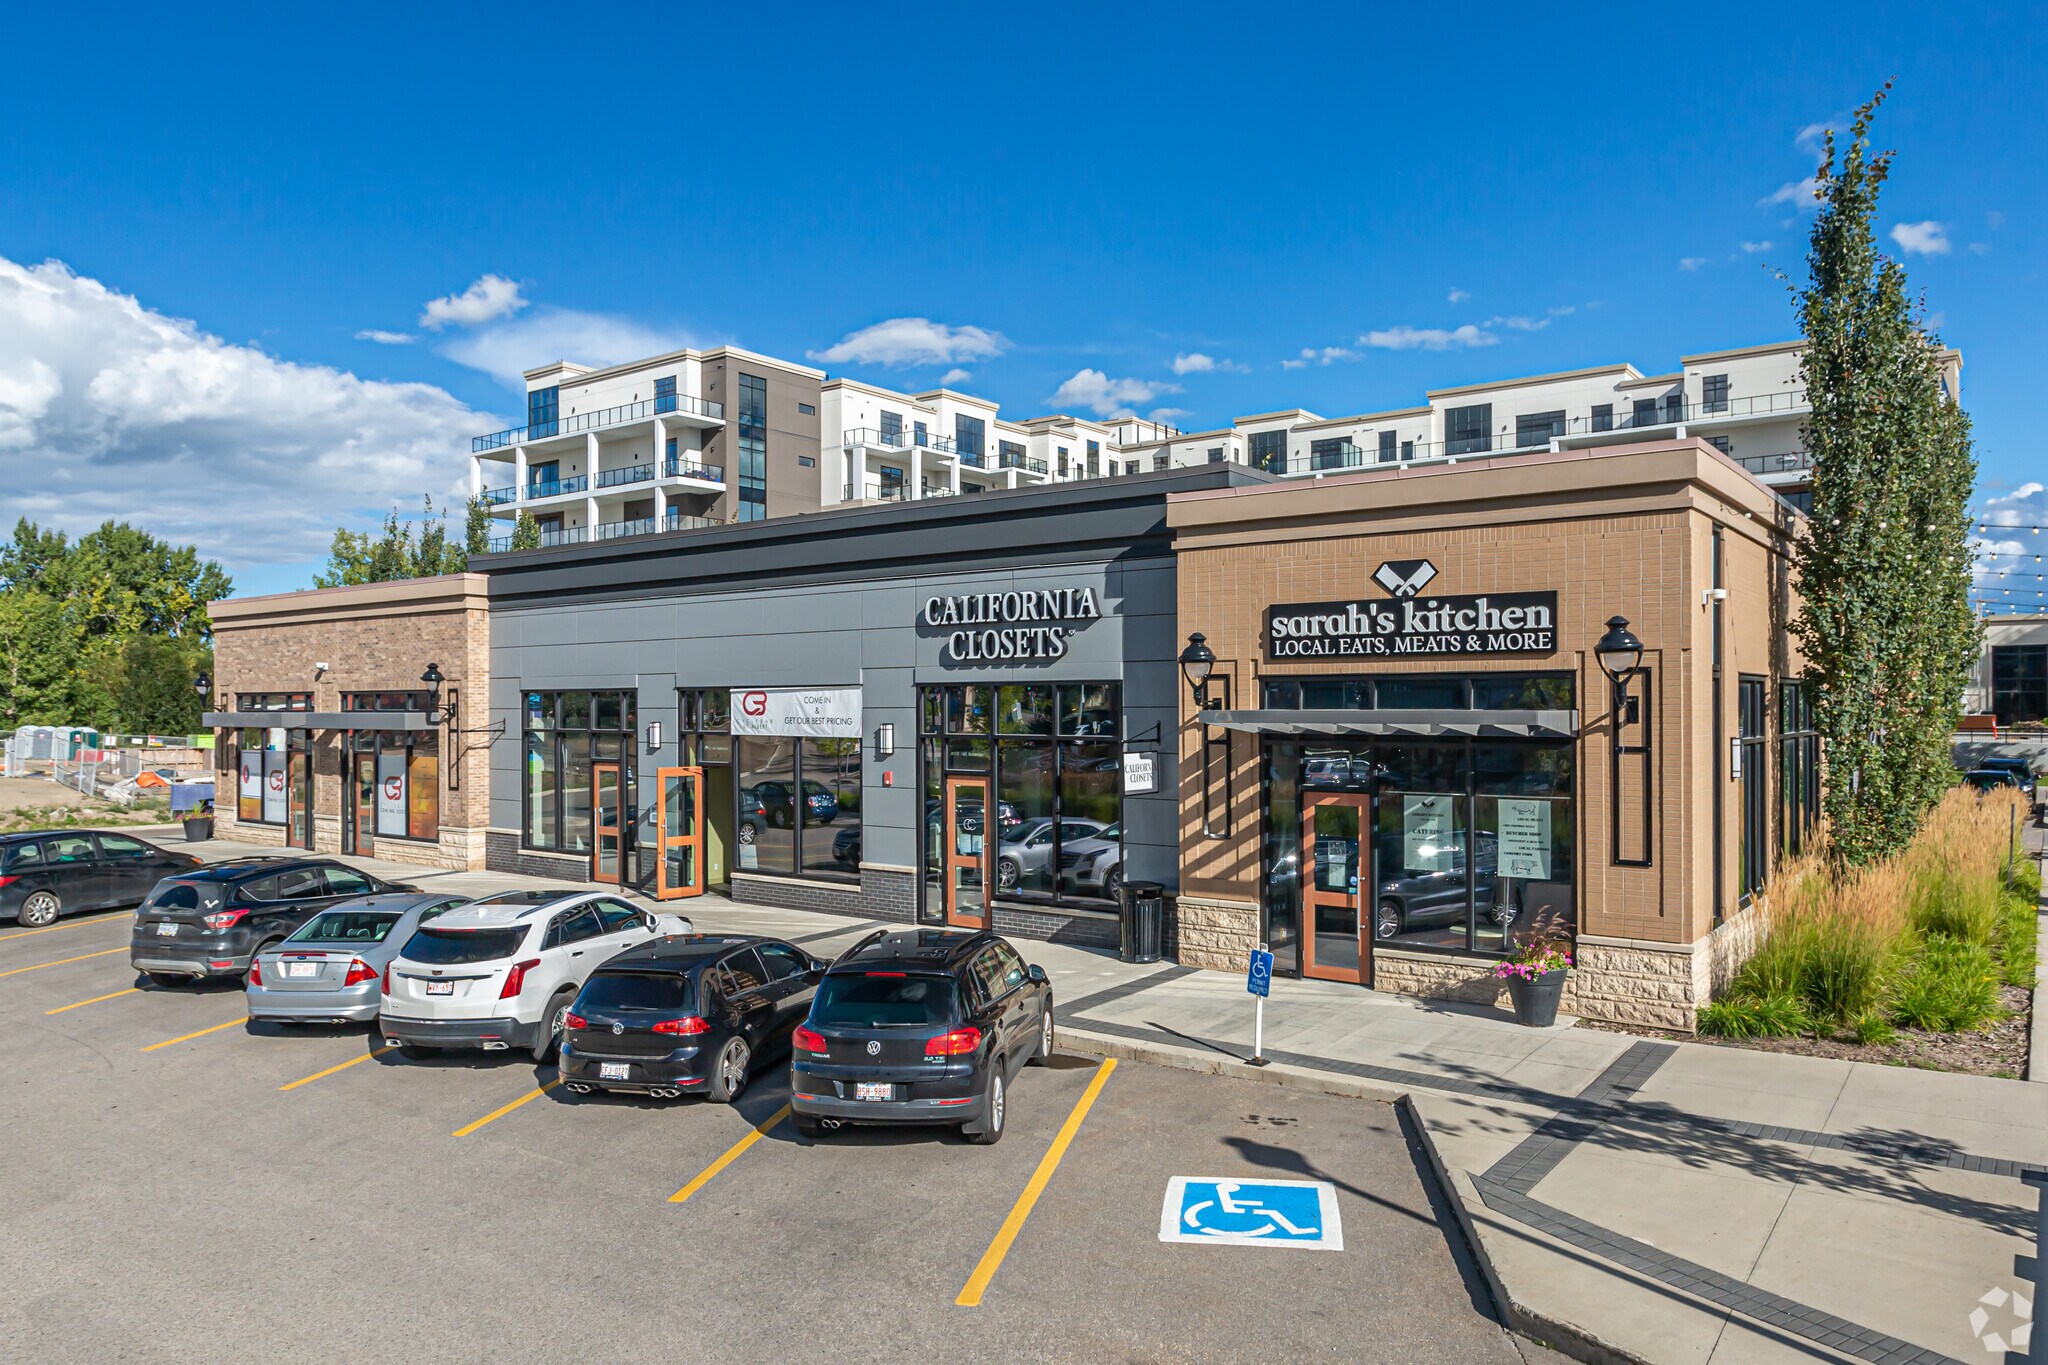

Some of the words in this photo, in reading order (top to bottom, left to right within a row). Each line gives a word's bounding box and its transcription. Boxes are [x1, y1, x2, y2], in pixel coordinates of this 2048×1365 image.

[925, 587, 1099, 626] CALIFORNIA
[1271, 603, 1395, 638] sarah's
[1402, 597, 1553, 633] kitchen
[949, 627, 1064, 661] CLOSETS
[1275, 639, 1336, 656] LOCAL
[1338, 636, 1390, 656] EATS,
[1395, 635, 1461, 654] MEATS
[1466, 634, 1482, 651] &
[1487, 631, 1552, 651] MORE
[803, 696, 823, 704] COME
[823, 696, 832, 704] IN
[814, 707, 820, 715] &
[784, 717, 798, 726] GET
[797, 717, 811, 726] OUR
[811, 718, 825, 726] BEST
[826, 717, 853, 726] PRICING
